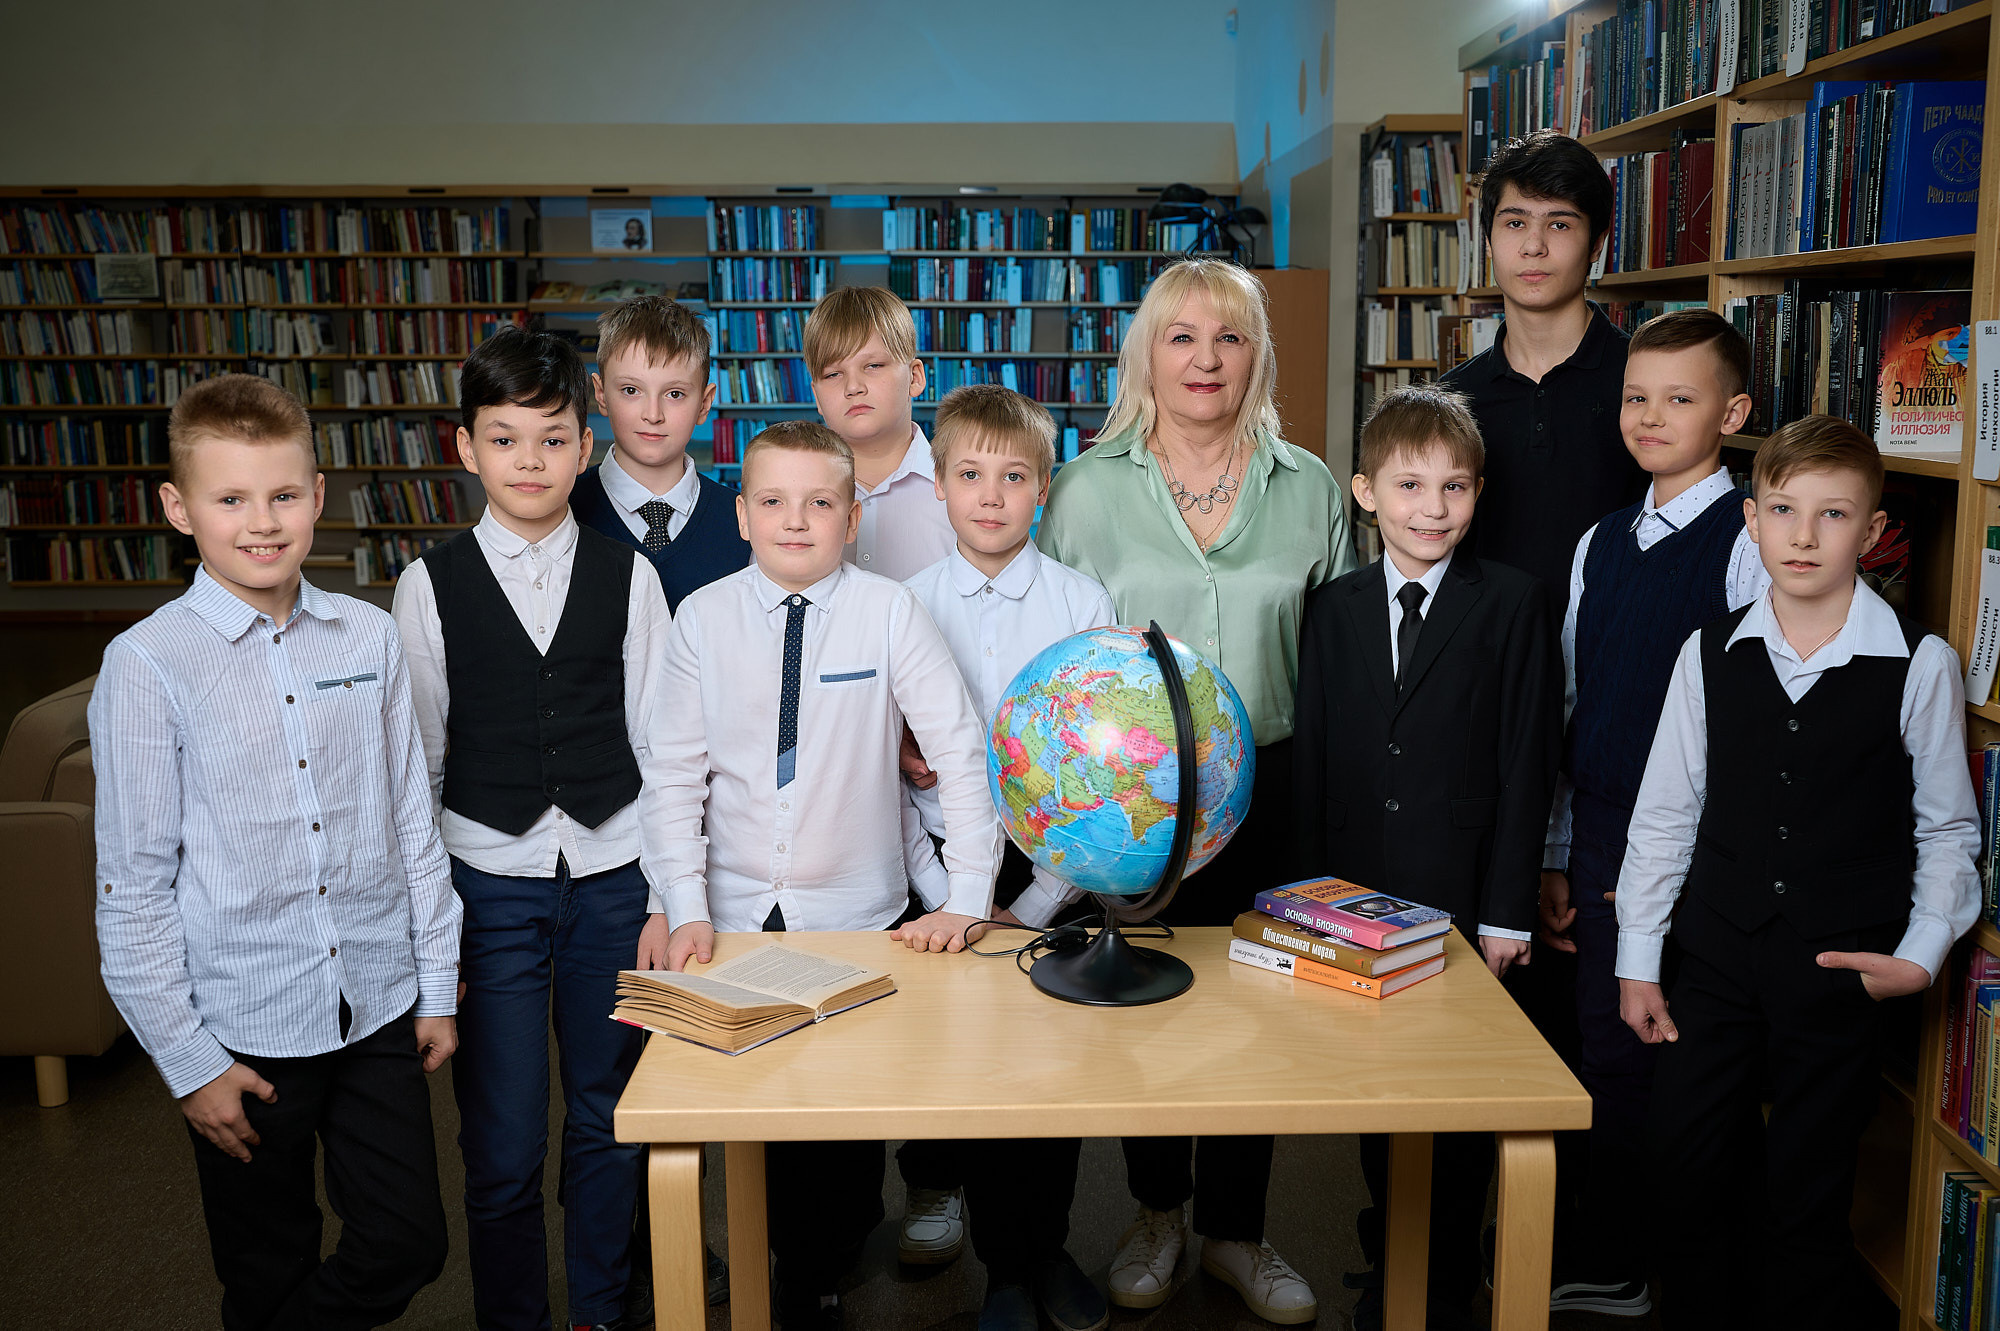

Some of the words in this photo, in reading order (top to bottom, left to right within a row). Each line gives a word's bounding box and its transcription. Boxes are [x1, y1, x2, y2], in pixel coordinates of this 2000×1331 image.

[1685, 31, 1694, 91] ФИЛОСОФИЯ
[1726, 48, 1734, 86] история
[1923, 105, 1952, 133] ПЕТР
[1954, 104, 1985, 124] ЧААД
[1927, 185, 1943, 204] PRO
[1945, 191, 1955, 203] ET
[1985, 326, 1998, 336] 88.1
[1923, 368, 1953, 387] Жак
[1980, 382, 1989, 440] История
[1991, 368, 2000, 451] психологии
[1890, 423, 1951, 435] ИЛЛЮЗИЯ
[1971, 597, 1990, 677] Психология
[1984, 607, 2000, 673] личности
[1284, 907, 1314, 925] ОСНОВЫ
[1315, 917, 1353, 938] БИОЭТИКИ
[1262, 927, 1310, 951] Общественная
[1311, 944, 1337, 961] мораль
